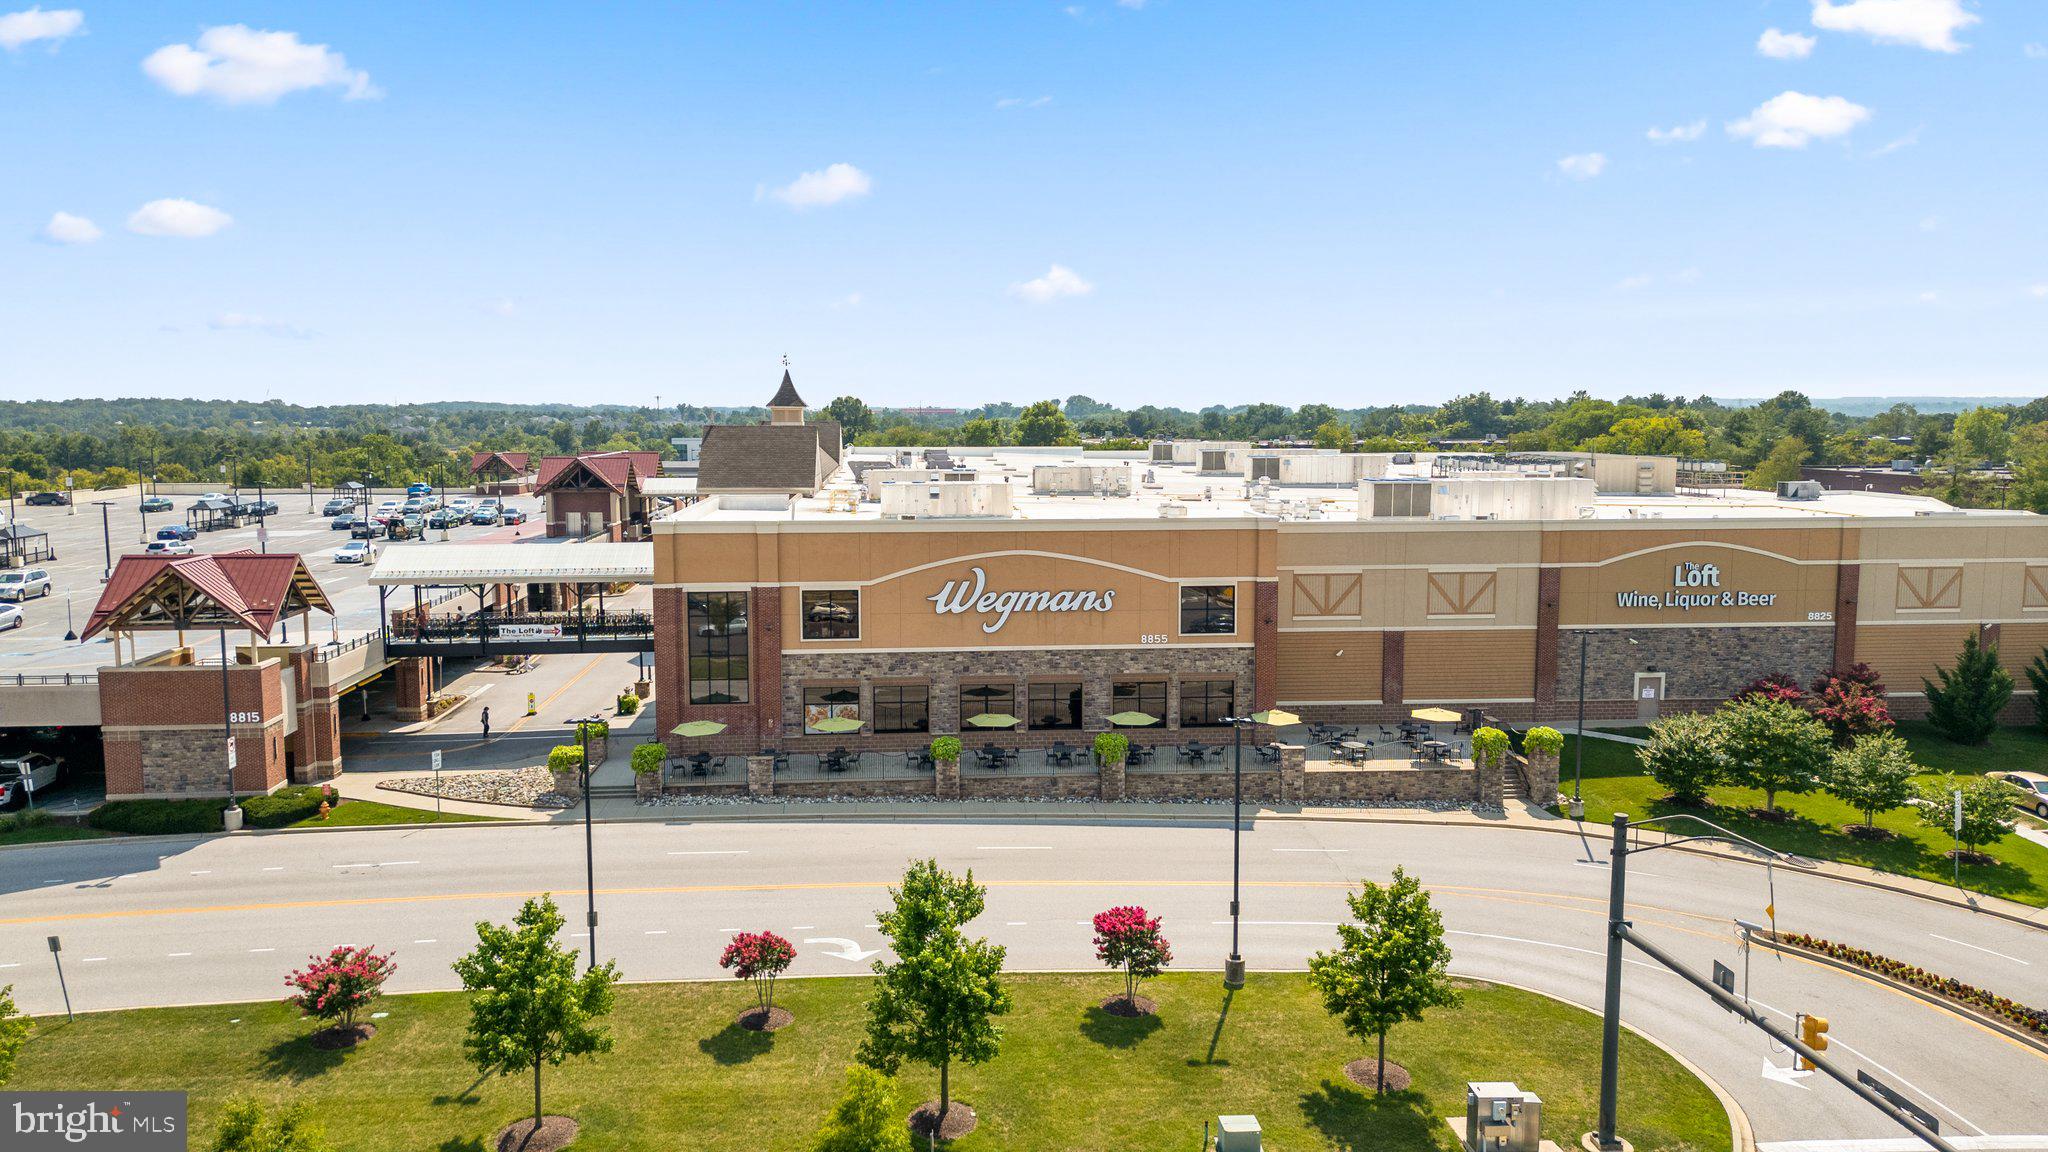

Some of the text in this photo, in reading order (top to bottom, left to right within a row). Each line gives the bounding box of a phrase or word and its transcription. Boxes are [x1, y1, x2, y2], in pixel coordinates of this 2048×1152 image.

[1684, 562, 1699, 571] The
[1674, 563, 1720, 587] Loft
[926, 567, 1116, 634] Wegmans
[1617, 590, 1777, 610] Wine, Liquor & Beer
[1808, 611, 1832, 621] 8825
[501, 627, 535, 635] The Loft
[1141, 634, 1168, 644] 8855
[230, 711, 260, 723] 8815
